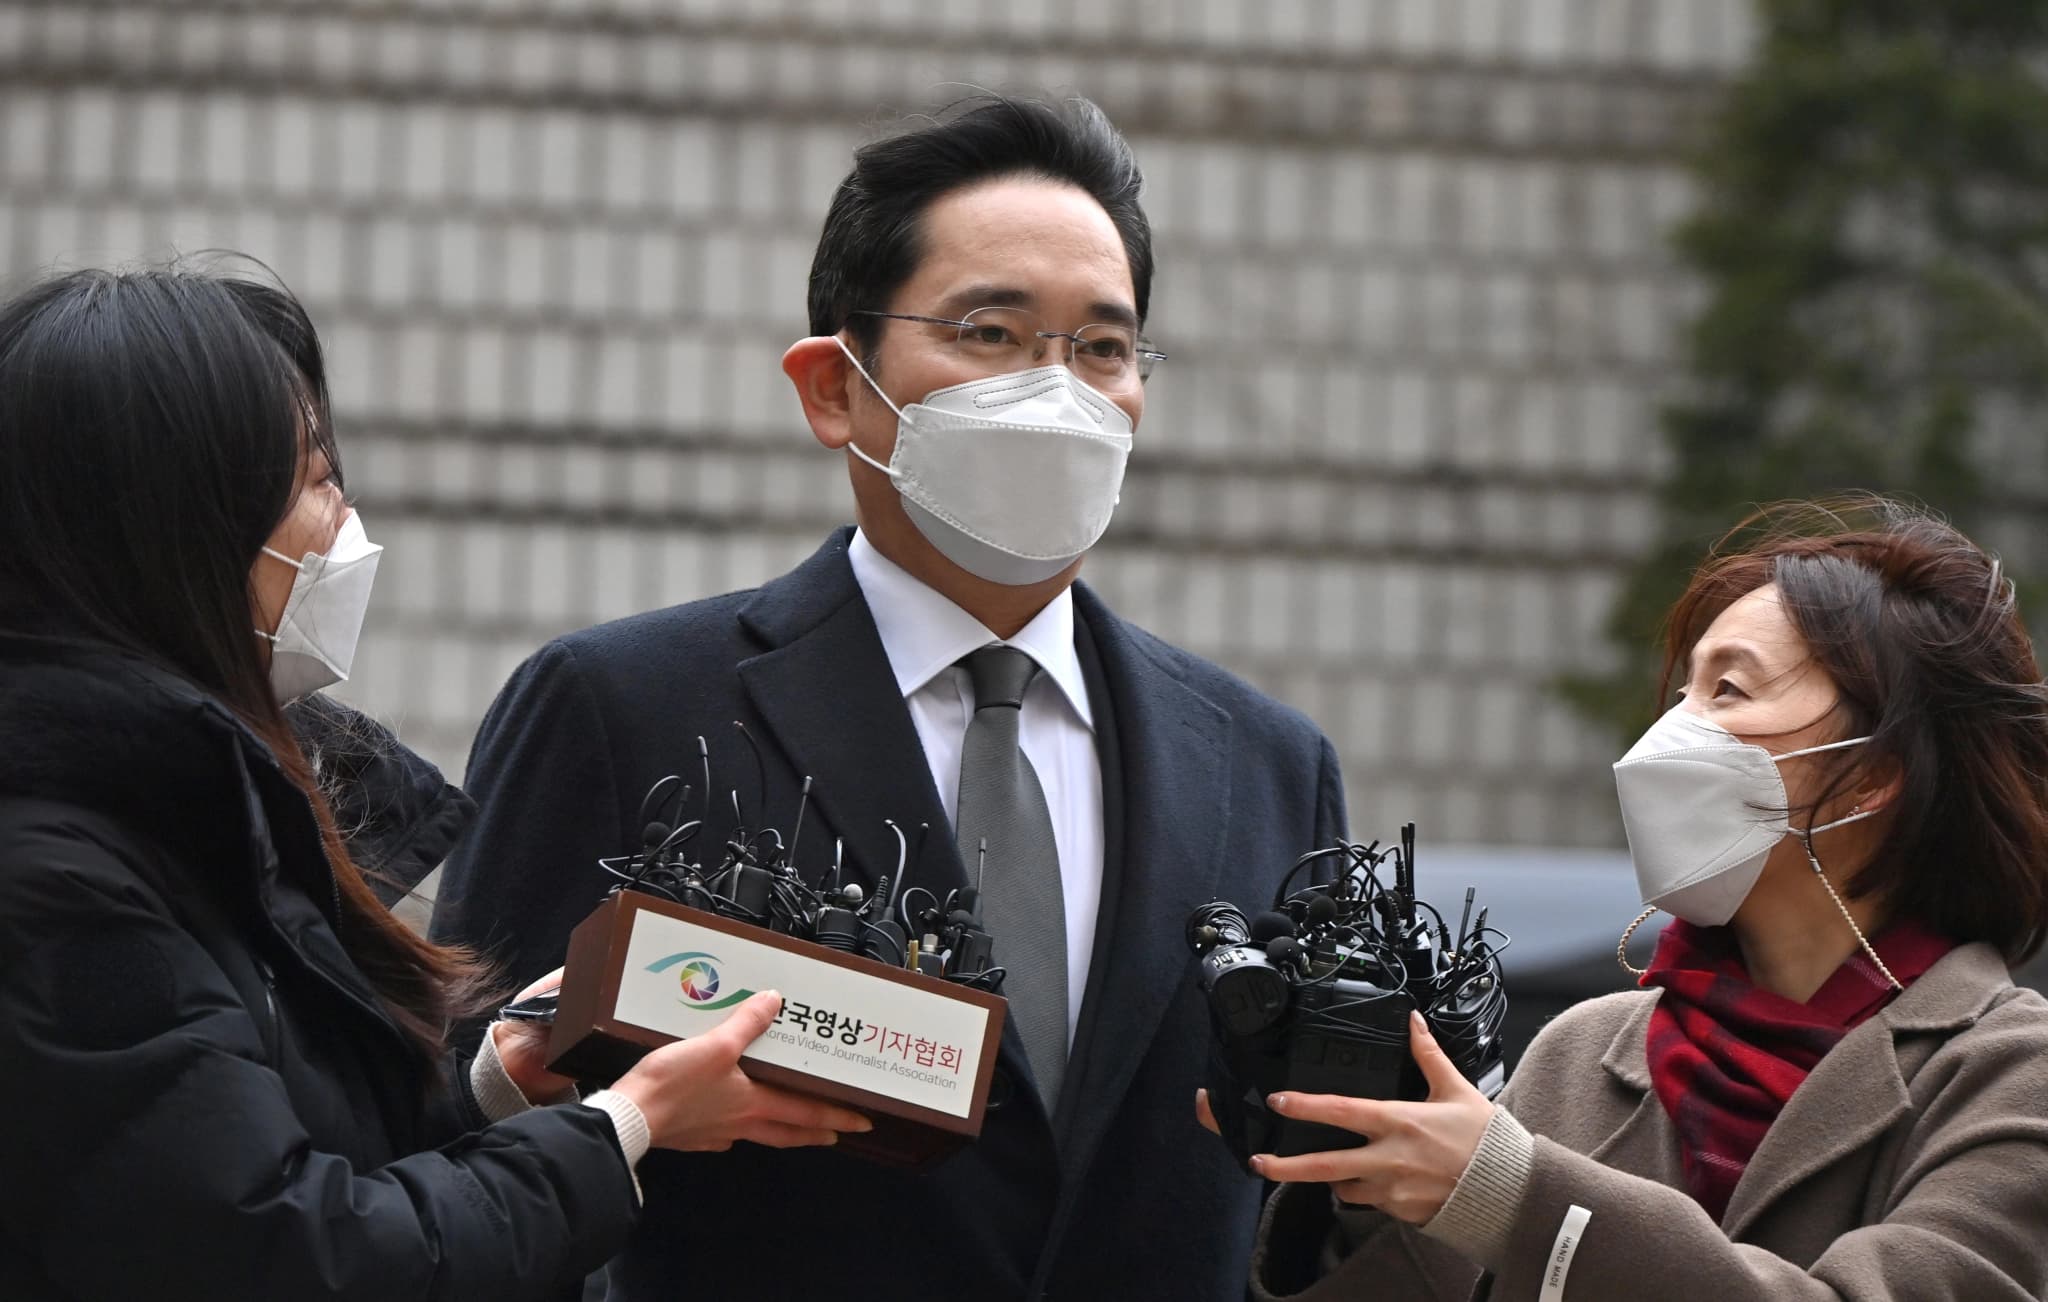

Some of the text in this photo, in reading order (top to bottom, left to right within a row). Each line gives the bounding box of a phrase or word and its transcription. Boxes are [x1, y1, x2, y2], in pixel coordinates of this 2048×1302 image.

[764, 1029, 957, 1090] orea Video Journalist Association
[1548, 1235, 1573, 1288] HAND MADE
